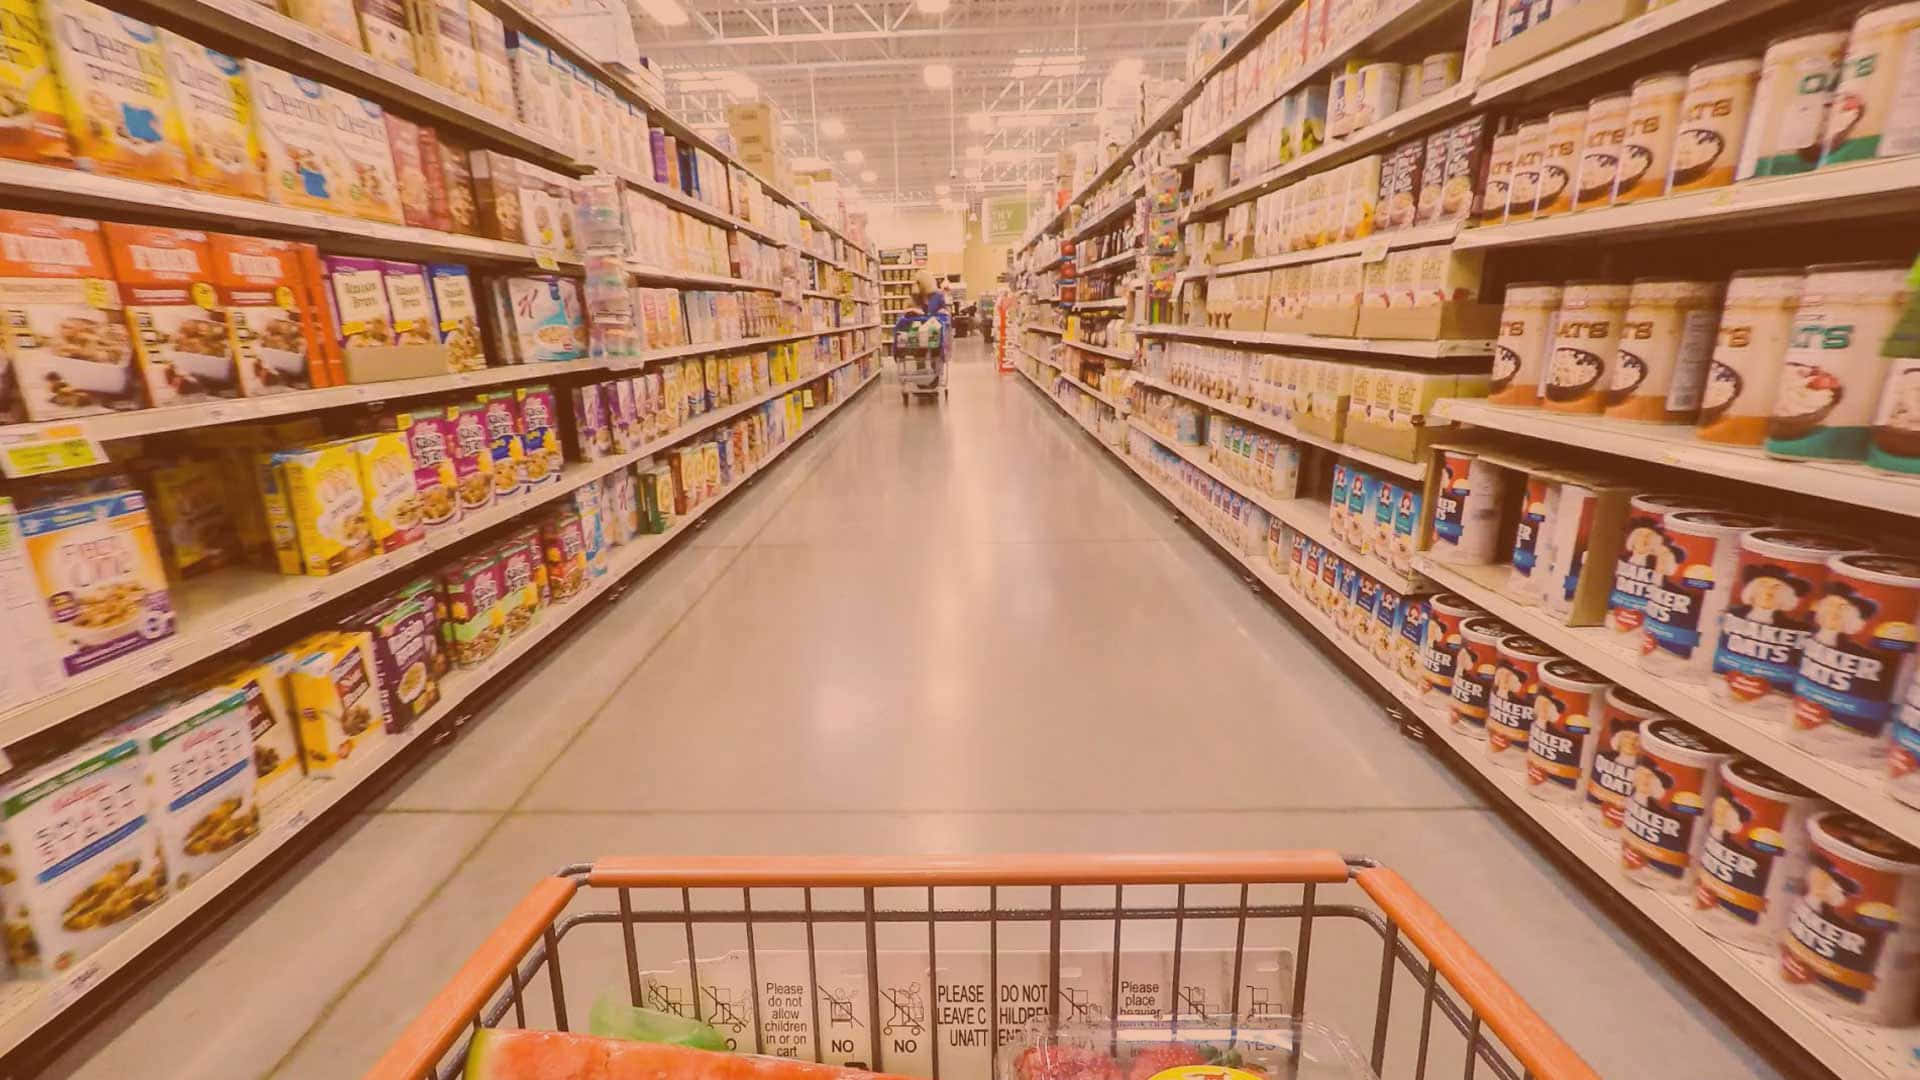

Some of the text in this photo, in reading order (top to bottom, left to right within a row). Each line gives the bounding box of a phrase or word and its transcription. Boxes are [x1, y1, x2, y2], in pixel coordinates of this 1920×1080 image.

[766, 982, 803, 994] Please
[938, 984, 1048, 1002] PLEASE DO NOT
[1121, 981, 1160, 994] Please
[768, 997, 802, 1007] do not
[1125, 995, 1155, 1007] place
[771, 1009, 799, 1020] allow
[937, 1007, 975, 1025] LEAVE
[764, 1021, 807, 1032] children
[766, 1034, 807, 1045] in or on
[776, 1046, 798, 1057] cart
[831, 1039, 854, 1053] NO
[894, 1039, 917, 1053] NO
